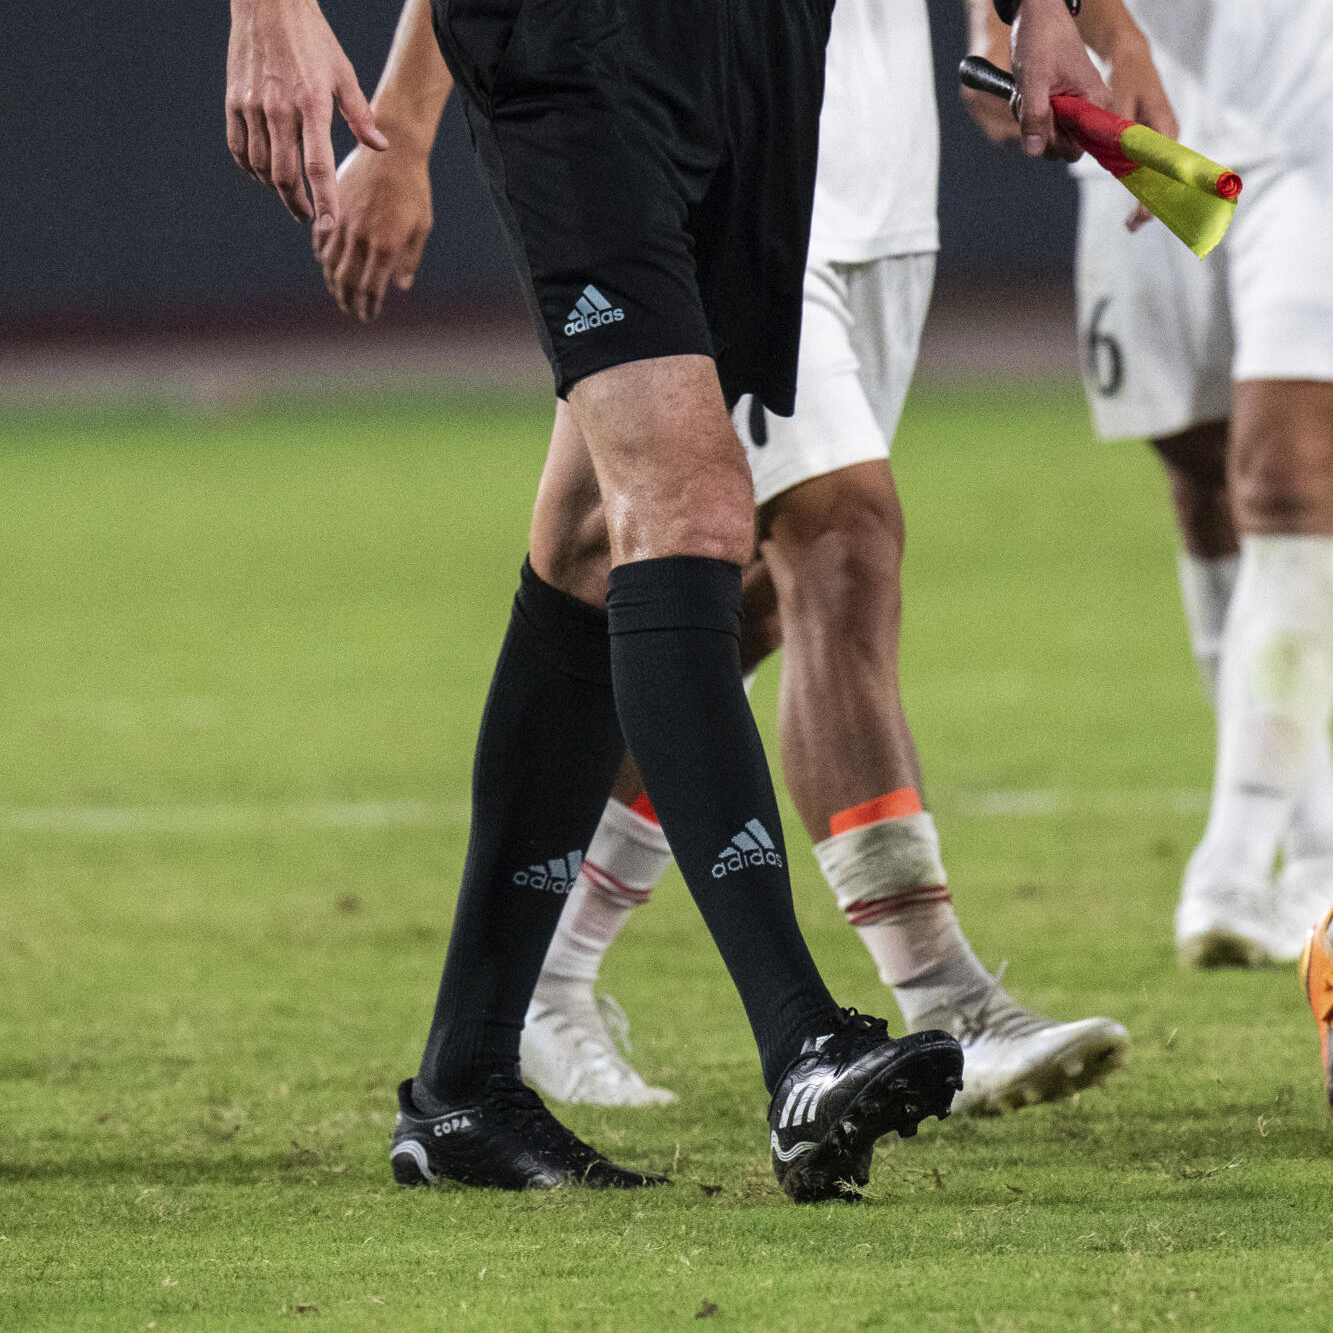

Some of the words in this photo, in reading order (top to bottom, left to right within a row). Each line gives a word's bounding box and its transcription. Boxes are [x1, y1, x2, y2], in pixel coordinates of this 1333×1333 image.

[564, 308, 625, 337] adidas
[1088, 294, 1124, 399] 6
[712, 847, 783, 879] adidas
[433, 1115, 472, 1137] COPA
